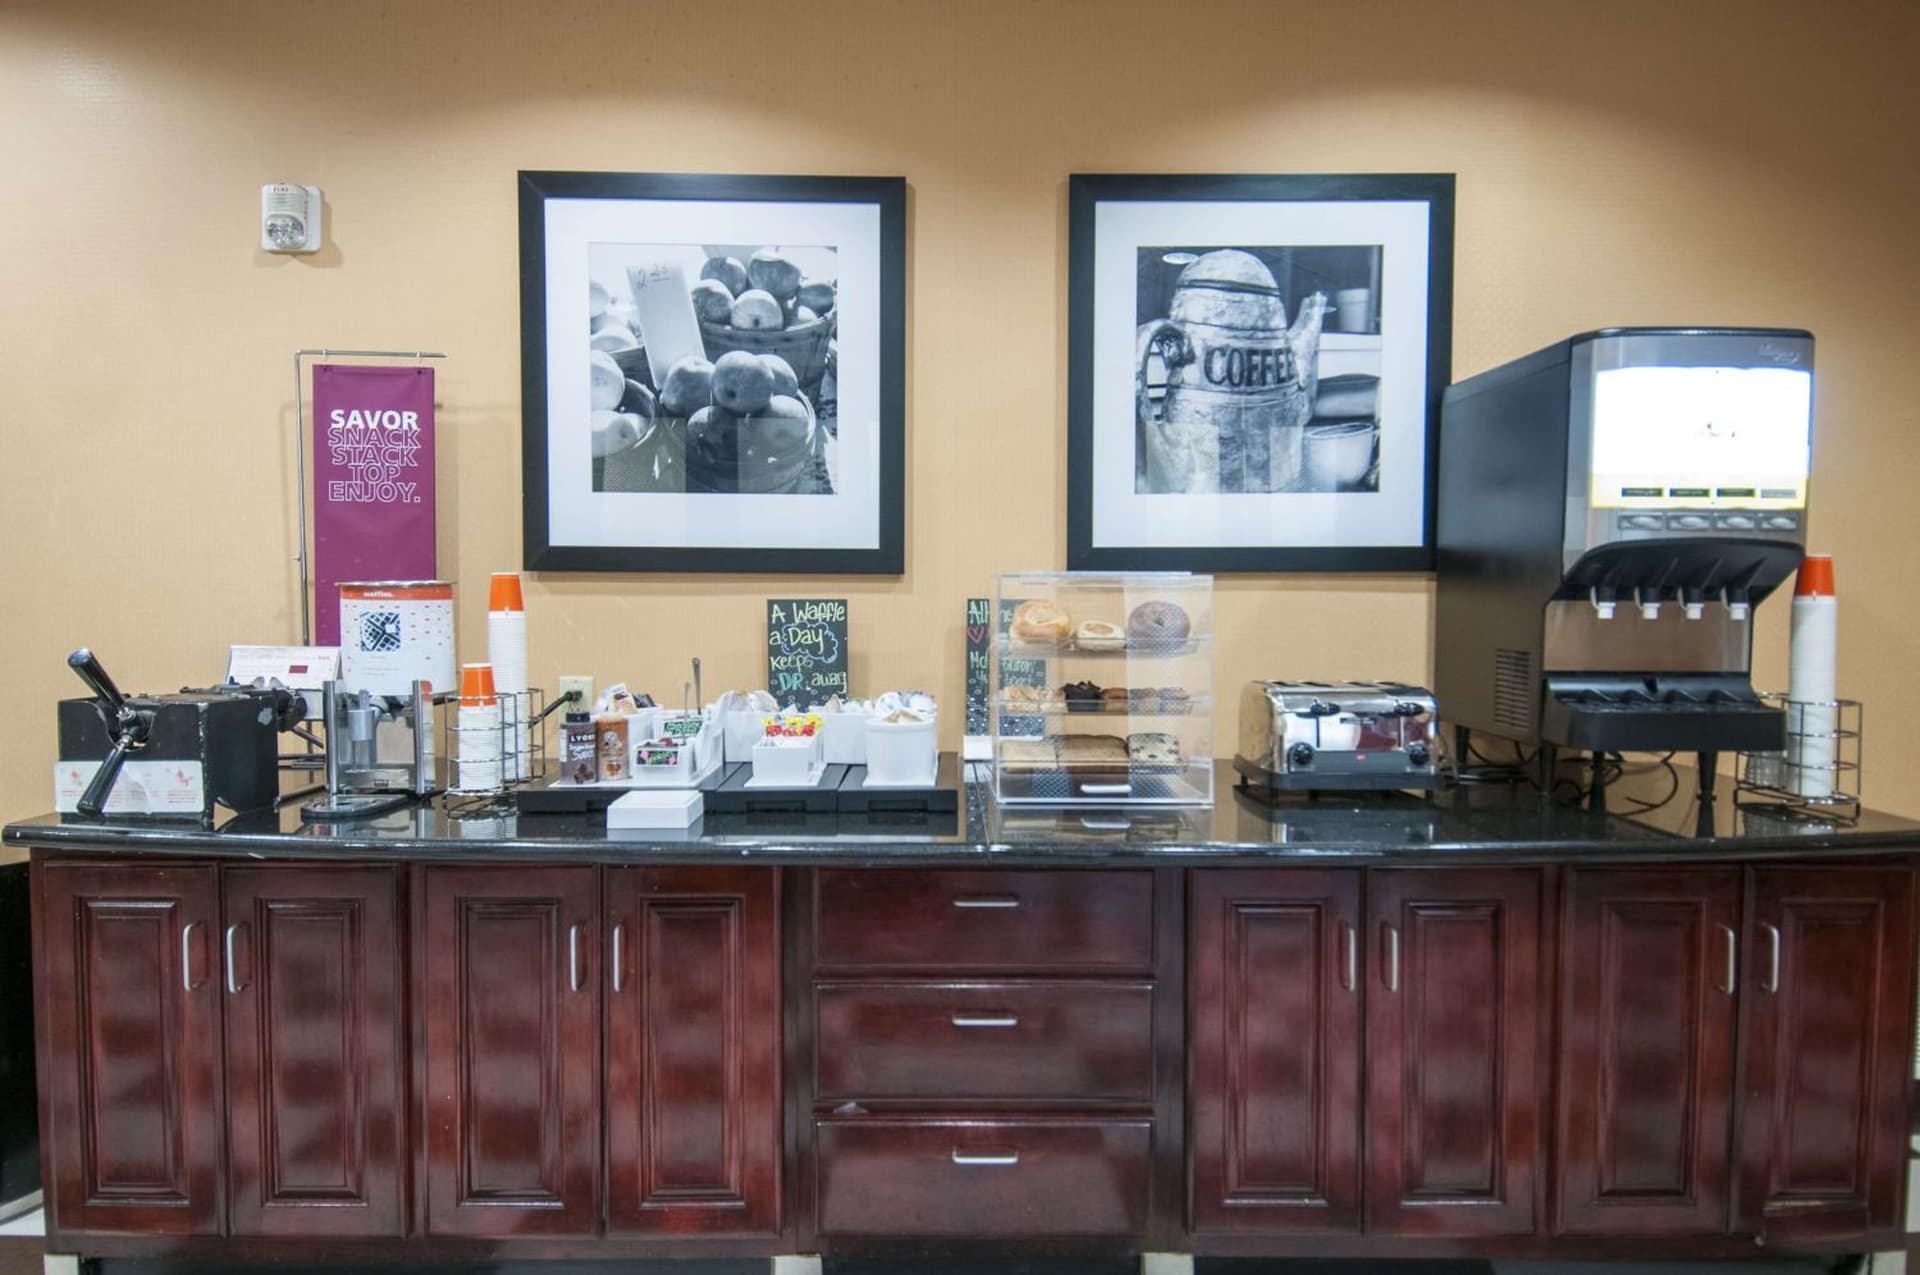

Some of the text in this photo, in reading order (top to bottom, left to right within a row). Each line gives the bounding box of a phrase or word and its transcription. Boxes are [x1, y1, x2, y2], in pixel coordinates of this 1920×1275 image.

[330, 409, 418, 431] SAVOR
[328, 427, 421, 448] SNACK
[331, 445, 418, 466] STACK
[347, 463, 401, 483] TOP
[328, 481, 421, 503] ENJOY.
[771, 602, 846, 624] A Waffle
[769, 627, 824, 655] a Day
[811, 671, 847, 694] away
